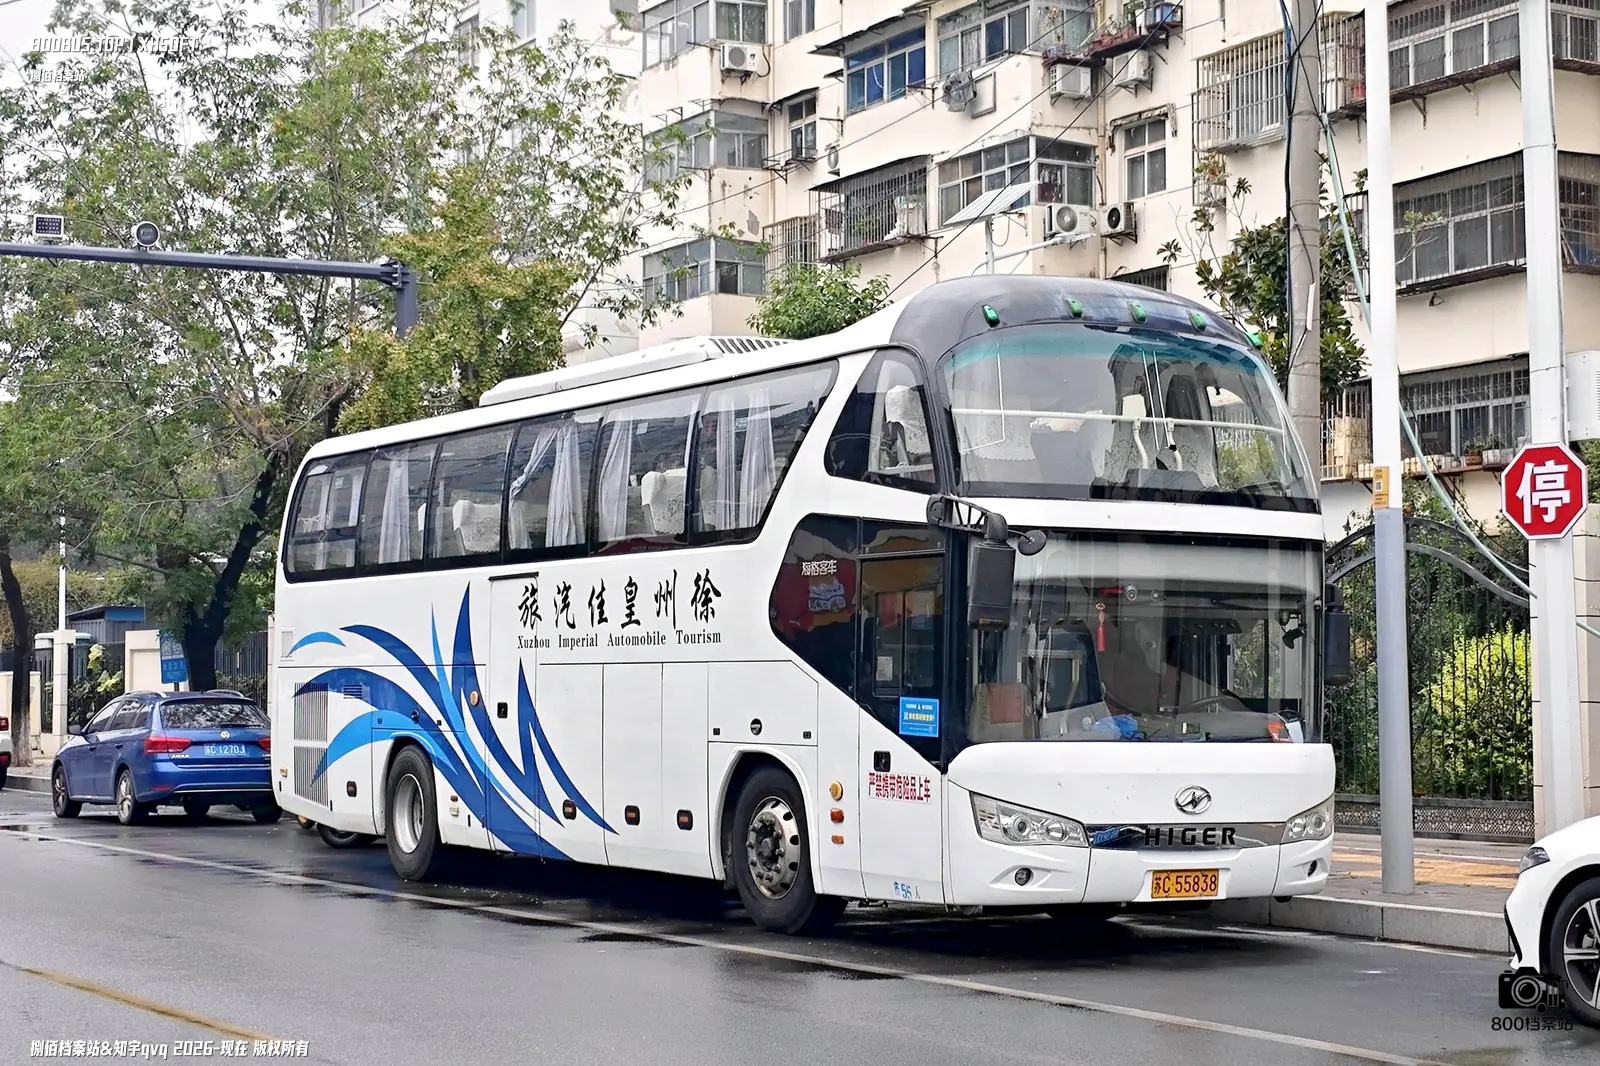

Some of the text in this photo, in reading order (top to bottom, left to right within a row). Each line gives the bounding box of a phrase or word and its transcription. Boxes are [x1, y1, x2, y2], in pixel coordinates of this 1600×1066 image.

[1515, 459, 1571, 524] 停
[517, 629, 722, 650] Xuzhou Imperial Automobile Tourism
[868, 772, 931, 802] 严禁携带危险品上车
[1144, 827, 1236, 846] HIGER
